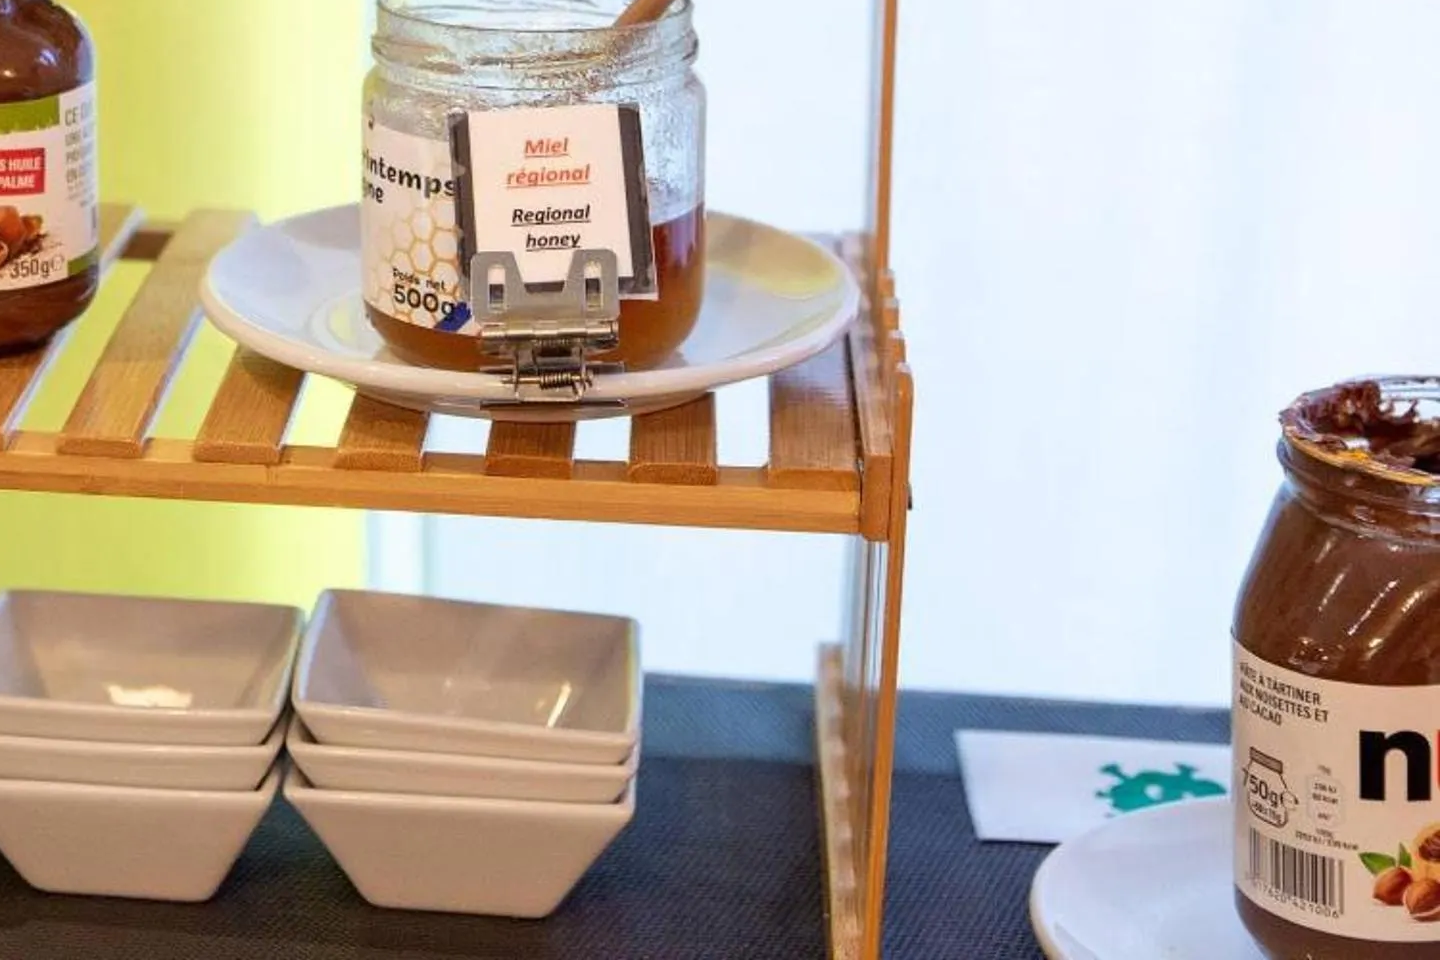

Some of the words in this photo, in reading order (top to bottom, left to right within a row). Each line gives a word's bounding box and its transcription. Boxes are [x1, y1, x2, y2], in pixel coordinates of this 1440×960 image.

[524, 138, 569, 155] Miel
[8, 156, 41, 172] HUILE
[507, 164, 591, 186] régional
[512, 205, 591, 224] Regional
[526, 233, 581, 248] honey
[1255, 687, 1312, 719] NOISETTES
[1314, 707, 1329, 723] ET
[1359, 729, 1440, 802] n
